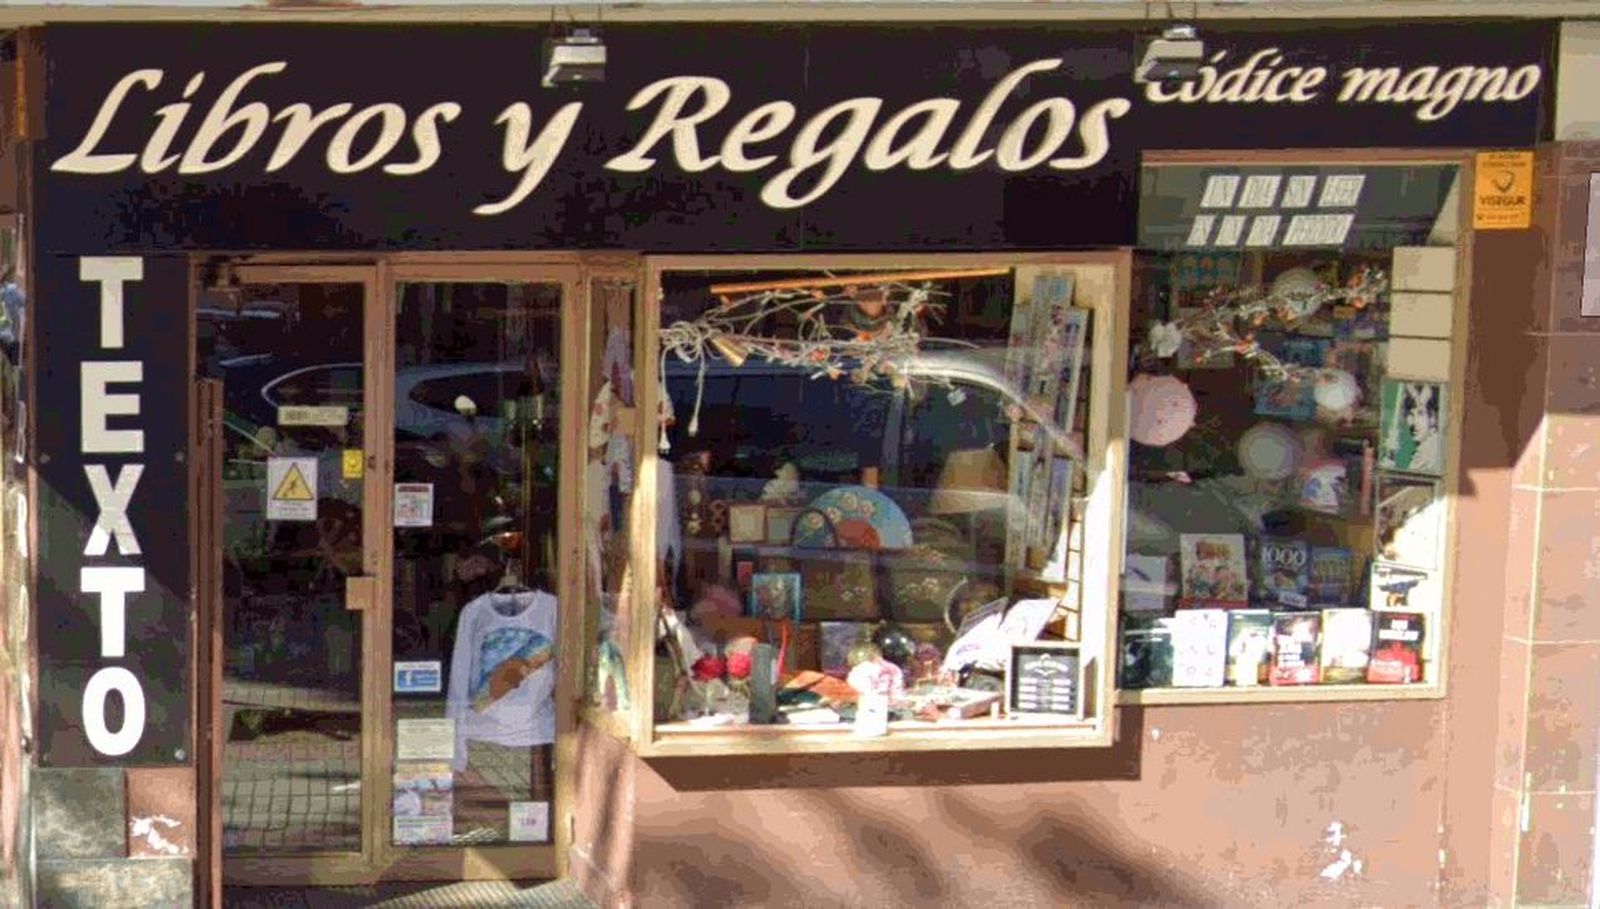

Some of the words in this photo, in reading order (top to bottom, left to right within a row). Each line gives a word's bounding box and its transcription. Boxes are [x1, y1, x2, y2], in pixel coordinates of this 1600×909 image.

[50, 61, 462, 175] Libros
[472, 101, 583, 215] y
[604, 57, 1131, 209] Regalos
[1337, 64, 1541, 121] magno
[79, 256, 147, 757] TEXTO
